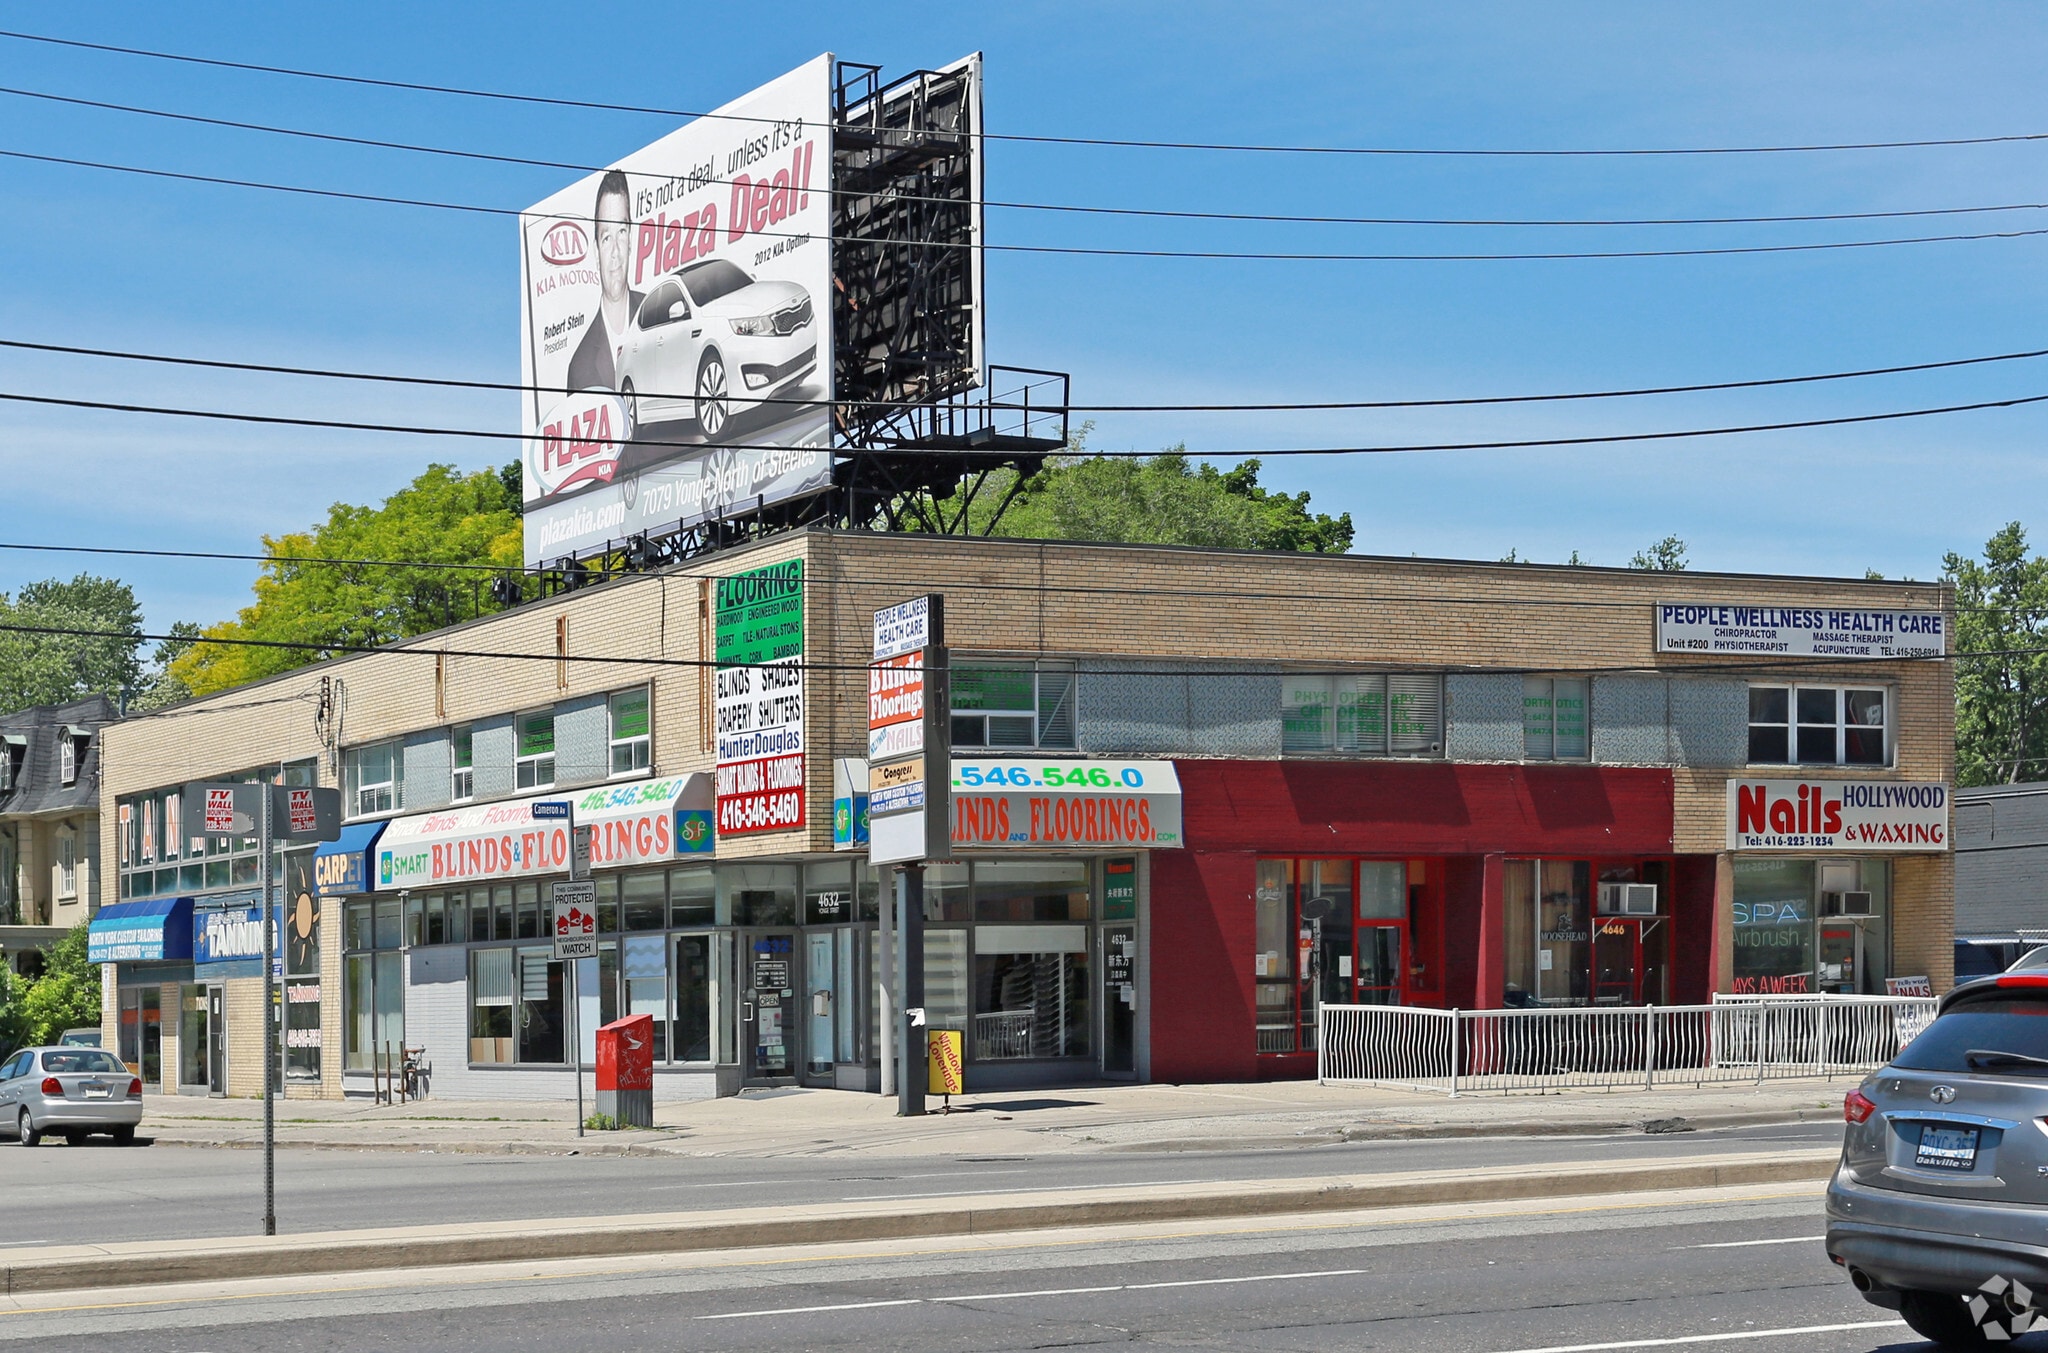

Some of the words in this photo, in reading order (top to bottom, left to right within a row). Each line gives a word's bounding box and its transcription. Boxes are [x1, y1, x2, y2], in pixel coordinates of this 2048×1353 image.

[636, 188, 653, 218] It's
[656, 176, 674, 208] not
[677, 174, 685, 199] a
[688, 155, 723, 193] deal...
[727, 134, 768, 175] unless
[772, 119, 790, 153] it's
[794, 117, 803, 141] a
[635, 202, 717, 285] Plaza
[728, 140, 814, 244] Deal!
[549, 230, 584, 257] KIA
[754, 247, 772, 267] 2012
[773, 241, 784, 258] KIA
[536, 275, 557, 297] KIA
[559, 269, 600, 287] MOTORS
[544, 319, 566, 340] Robert
[567, 312, 585, 331] Stein
[544, 336, 568, 356] President
[543, 404, 614, 473] PLAZA
[598, 463, 612, 476] KIA
[642, 484, 672, 517] 7079
[675, 474, 711, 507] Yonge
[714, 460, 749, 493] North
[752, 452, 767, 480] of
[769, 440, 818, 477] Steeles
[540, 501, 626, 554] plazakia.com
[717, 562, 799, 609] FLOORING
[717, 611, 743, 626] HARDWOOD
[748, 603, 779, 620] ENGINEERED
[781, 599, 799, 614] WOOD
[875, 607, 896, 629] PEOPLE
[897, 598, 927, 621] WELLNESS
[1663, 605, 1729, 627] PEOPLE
[1734, 608, 1824, 631] WELLNESS
[1829, 613, 1894, 632] HEALTH
[1899, 614, 1942, 635] CARE
[717, 634, 734, 648] CARPET
[879, 623, 904, 646] HEALTH
[905, 618, 922, 638] CARE
[1714, 627, 1777, 639] CHIROPRACTOR
[1812, 632, 1849, 643] MASSAGE
[1852, 634, 1894, 645] THERAPIST
[749, 651, 762, 663] CORK
[773, 643, 799, 658] BAMBOO
[1667, 638, 1686, 650] Unit
[1687, 638, 1709, 650] #200
[1714, 640, 1789, 652] PHYSIOTHERAPIST
[1812, 643, 1870, 656] ACUPUNCTURE
[1880, 646, 1895, 656] TEL:
[718, 668, 750, 699] BLINDS
[761, 659, 799, 692] SHADES
[870, 655, 923, 694] Blinds
[718, 702, 752, 733] DRAPERY
[758, 694, 800, 728] SHUTTERS
[870, 688, 923, 721] Floorings
[719, 728, 799, 760] HunterDouglas
[886, 725, 923, 752] NAILS
[717, 766, 736, 797] SMART
[737, 762, 758, 794] BLINDS
[766, 755, 802, 790] FLOORINGS
[208, 801, 232, 809] WALL
[210, 791, 230, 800] TV
[291, 801, 313, 810] WALL
[292, 791, 309, 800] TV
[579, 779, 683, 811] 416.546.546.0
[290, 809, 315, 817] MOUNTING
[534, 804, 559, 815] Cameron
[560, 807, 566, 815] Av
[721, 792, 799, 830] 416-546-5460
[951, 797, 1010, 842] INDS
[1009, 833, 1028, 842] AND
[1738, 784, 1842, 834] Nails
[1843, 785, 1945, 808] HOLLYWOOD
[421, 812, 459, 834] Blinds
[458, 811, 482, 828] And
[1845, 826, 1857, 841] &
[1859, 823, 1944, 844] WAXING
[394, 853, 428, 876] SMART
[431, 835, 512, 879] BLINDS
[521, 814, 670, 871] FLORINGS
[1745, 836, 1762, 846] Tel:
[1765, 836, 1833, 846] 416-223-1234
[555, 893, 594, 904] PROTECTED
[818, 892, 839, 907] 4632
[1733, 903, 1800, 924] SPA
[1540, 931, 1587, 941] MOOSEHEAD
[1602, 924, 1625, 935] 4646
[562, 943, 591, 954] WATCH
[753, 940, 789, 953] 4632
[288, 984, 320, 1003] TANNING
[1732, 976, 1755, 994] AYS
[1760, 976, 1768, 994] A
[1770, 975, 1808, 994] WEEK
[1900, 986, 1930, 997] NAILS
[929, 1041, 959, 1092] Coverings
[939, 1032, 963, 1075] Window
[1916, 1157, 1960, 1167] Oakville
